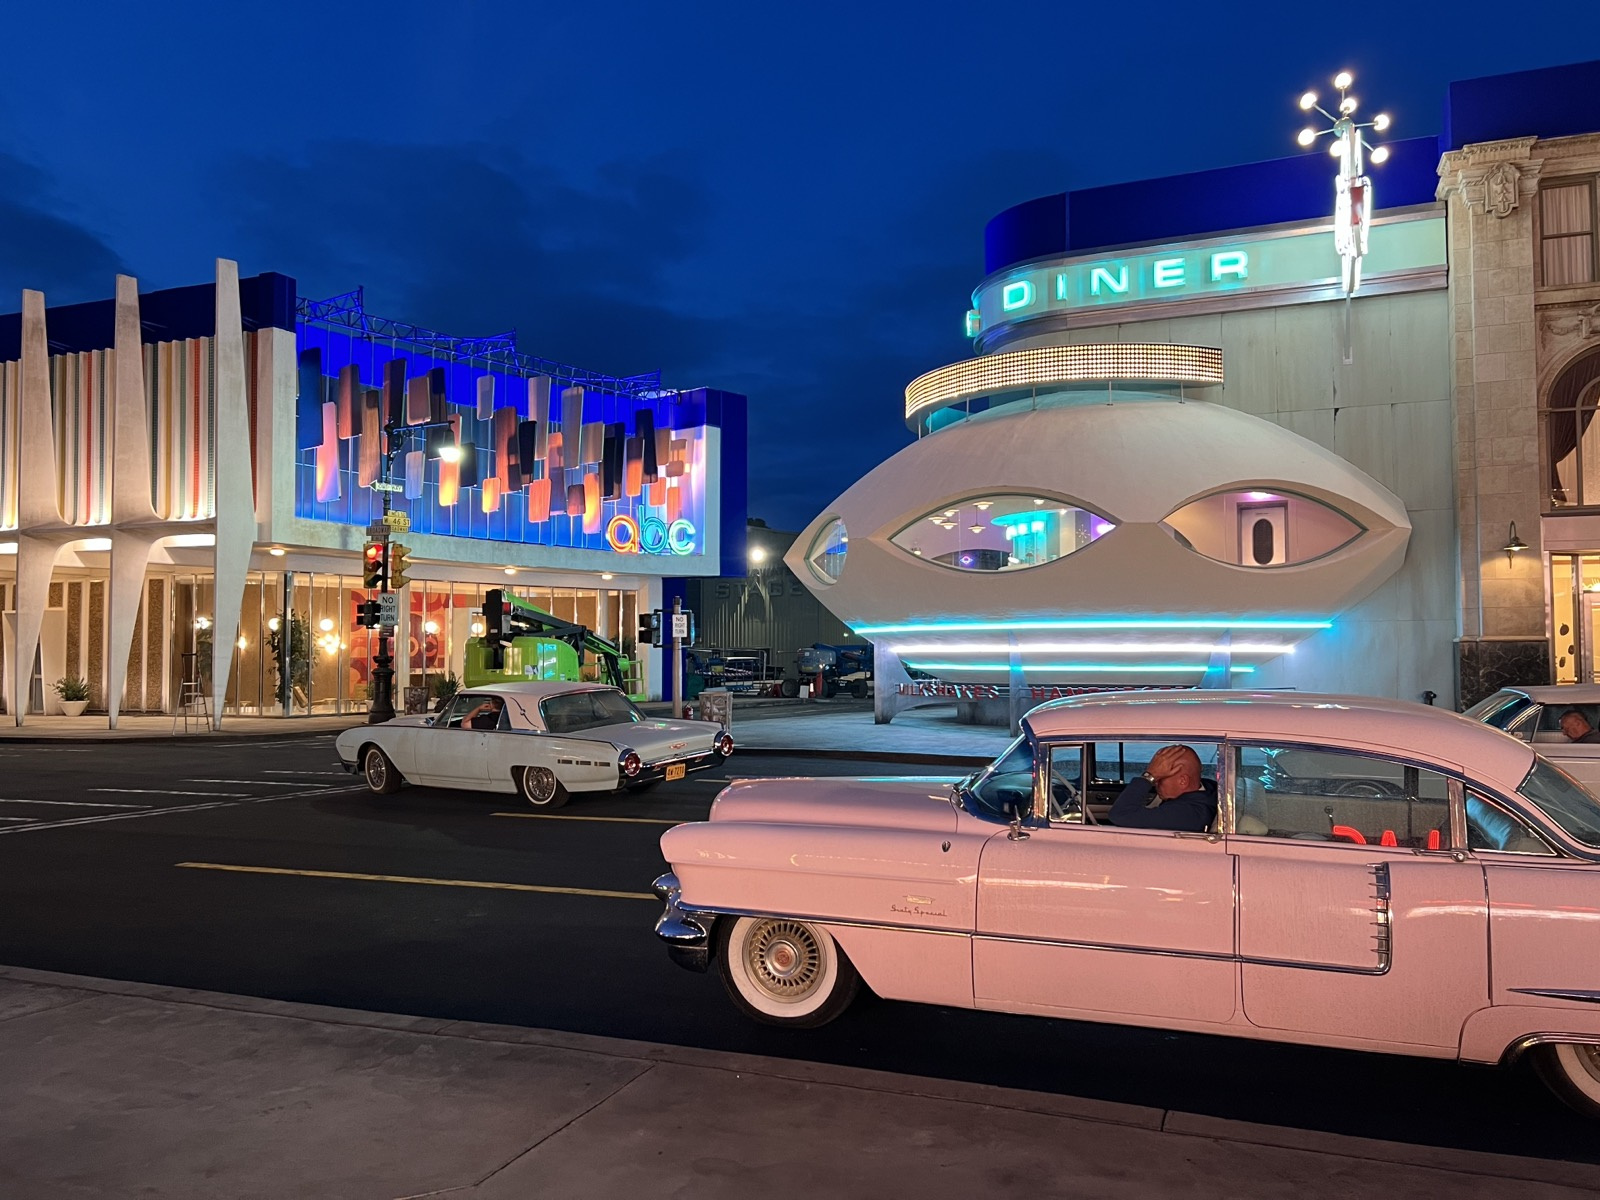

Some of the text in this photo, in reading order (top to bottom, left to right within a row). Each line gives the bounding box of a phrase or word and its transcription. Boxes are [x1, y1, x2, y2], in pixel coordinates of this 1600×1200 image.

[1003, 250, 1249, 312] DINER
[392, 518, 401, 526] 46
[605, 504, 696, 556] abc
[382, 596, 394, 604] NO
[380, 605, 396, 613] RIGHT
[380, 613, 395, 622] TURN
